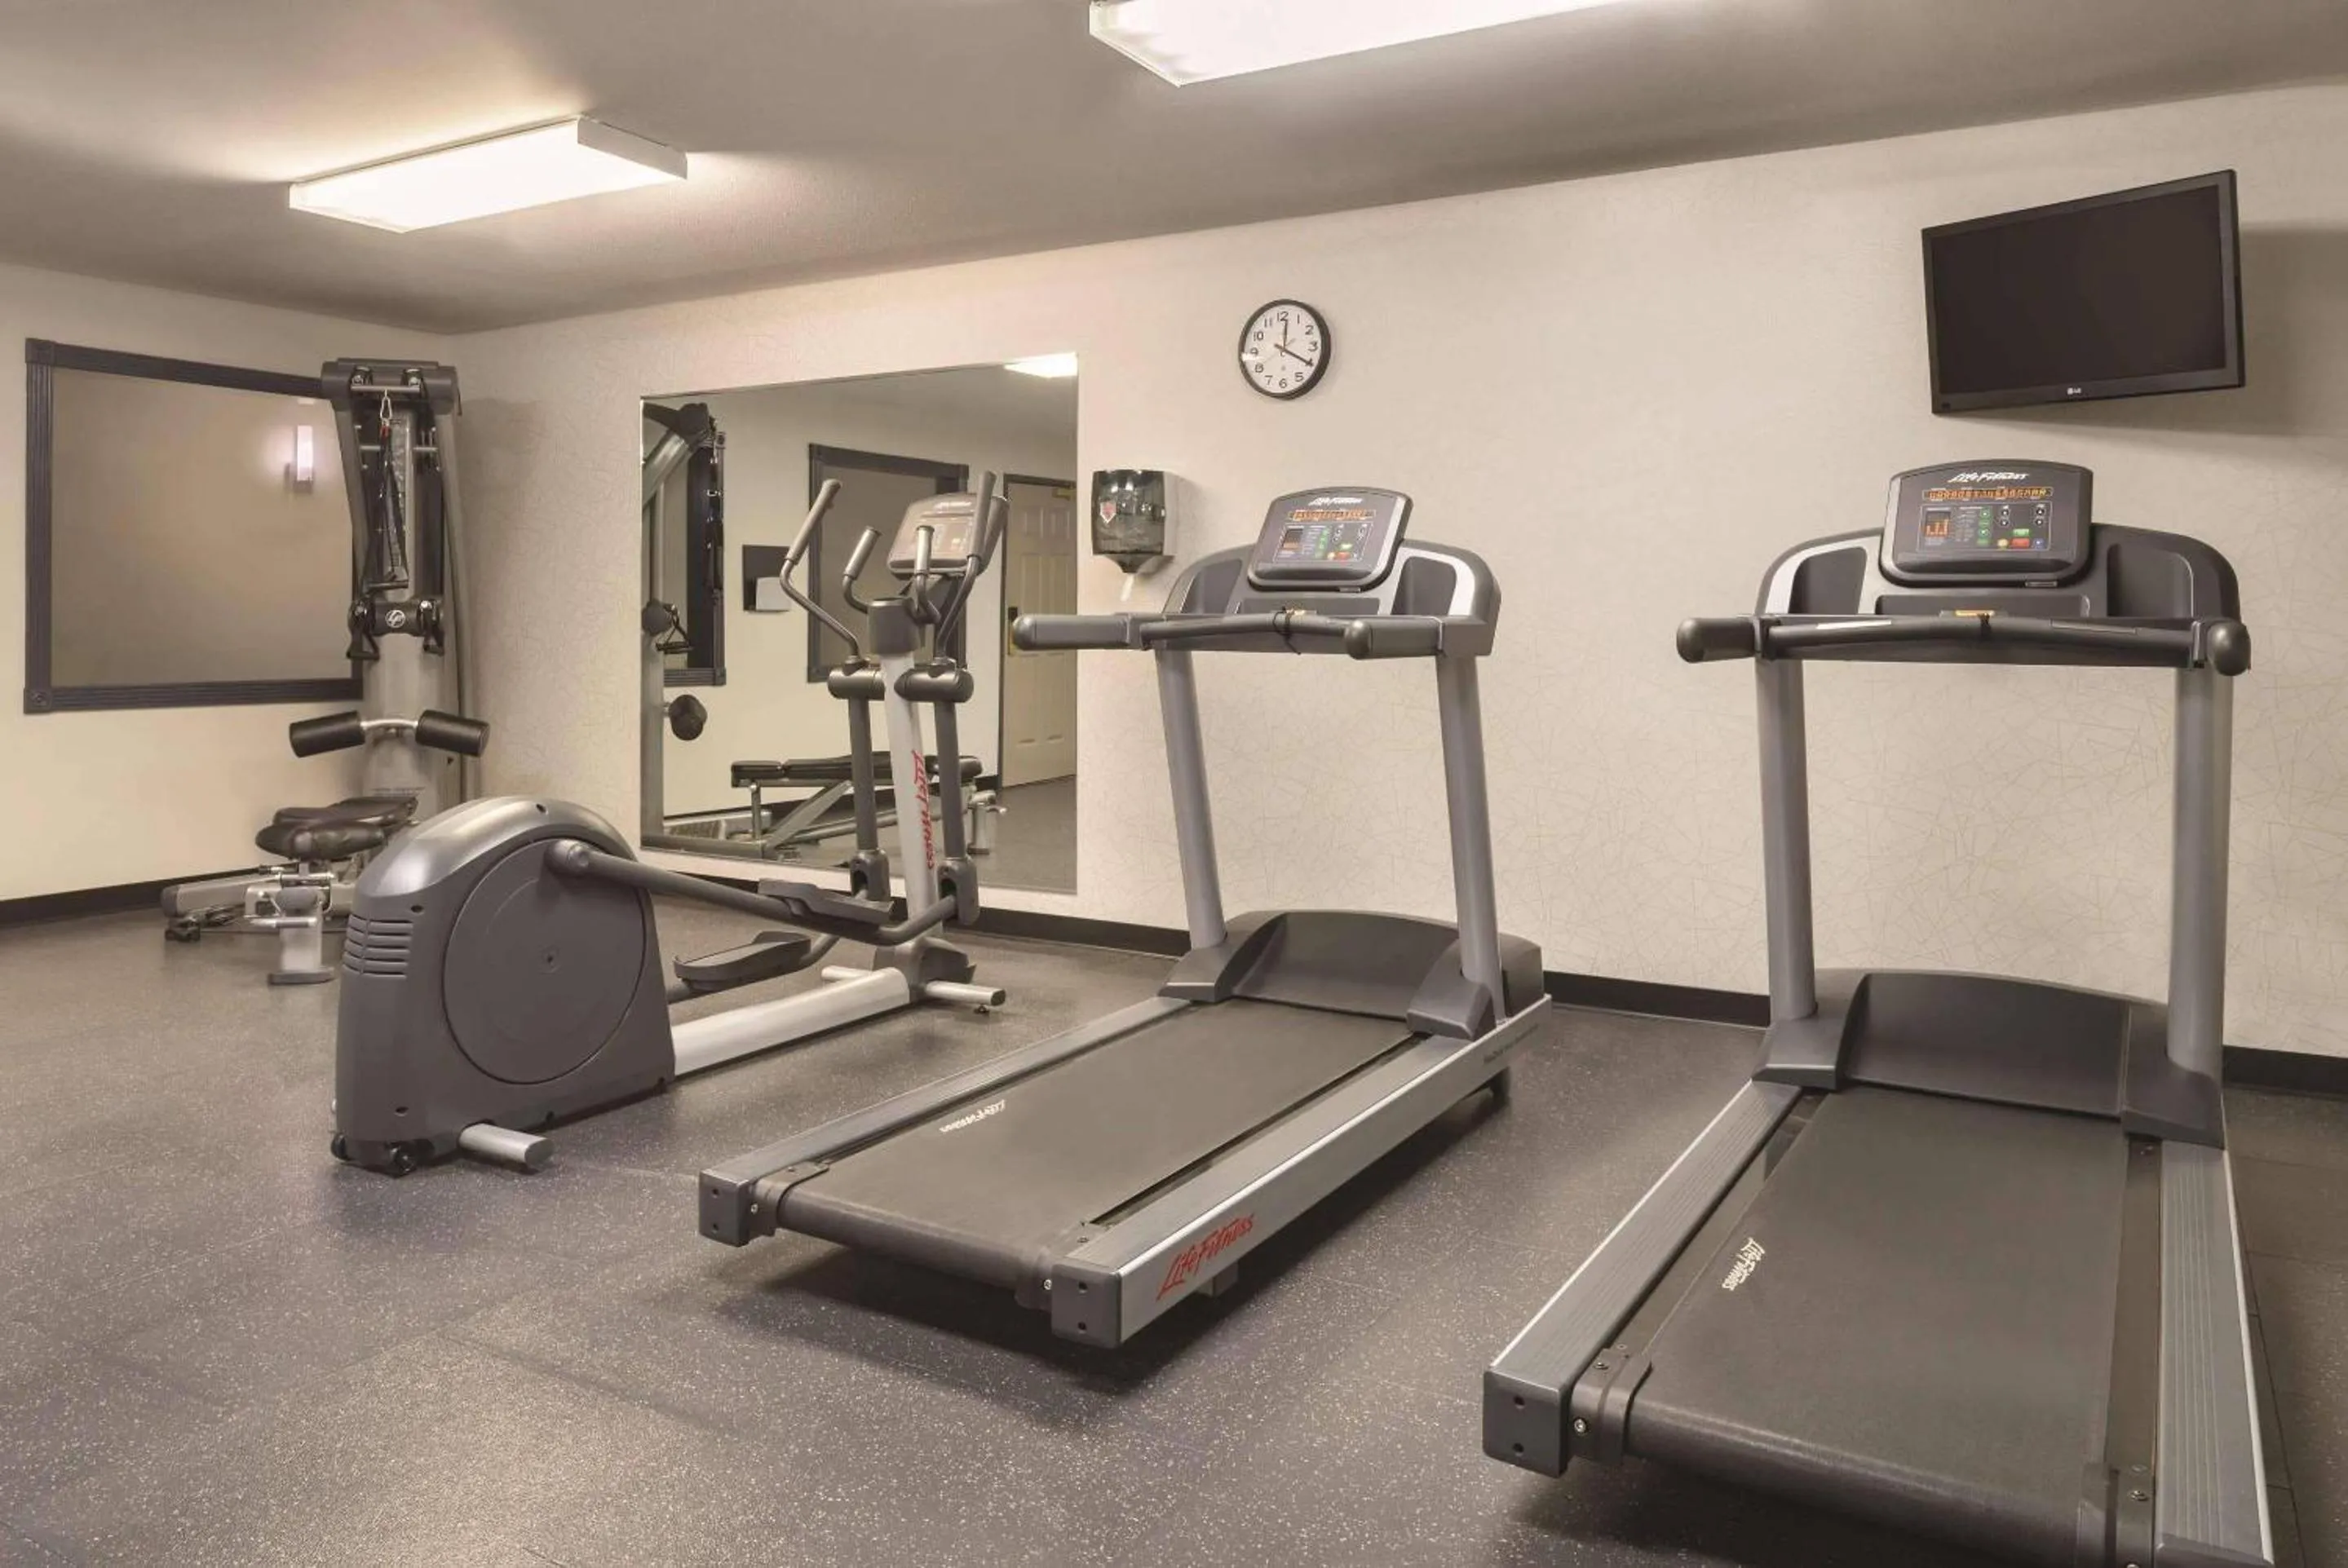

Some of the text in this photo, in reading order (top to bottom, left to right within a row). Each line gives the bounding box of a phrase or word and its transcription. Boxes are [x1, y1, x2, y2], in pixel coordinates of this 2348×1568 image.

[1276, 311, 1289, 322] 12
[1264, 317, 1272, 328] 11
[1305, 325, 1315, 336] 2
[1254, 331, 1264, 342] 10
[1308, 341, 1318, 352] 3
[1254, 362, 1263, 373] 8
[1265, 375, 1273, 386] 7
[1294, 372, 1303, 382] 5
[1279, 378, 1287, 389] 6
